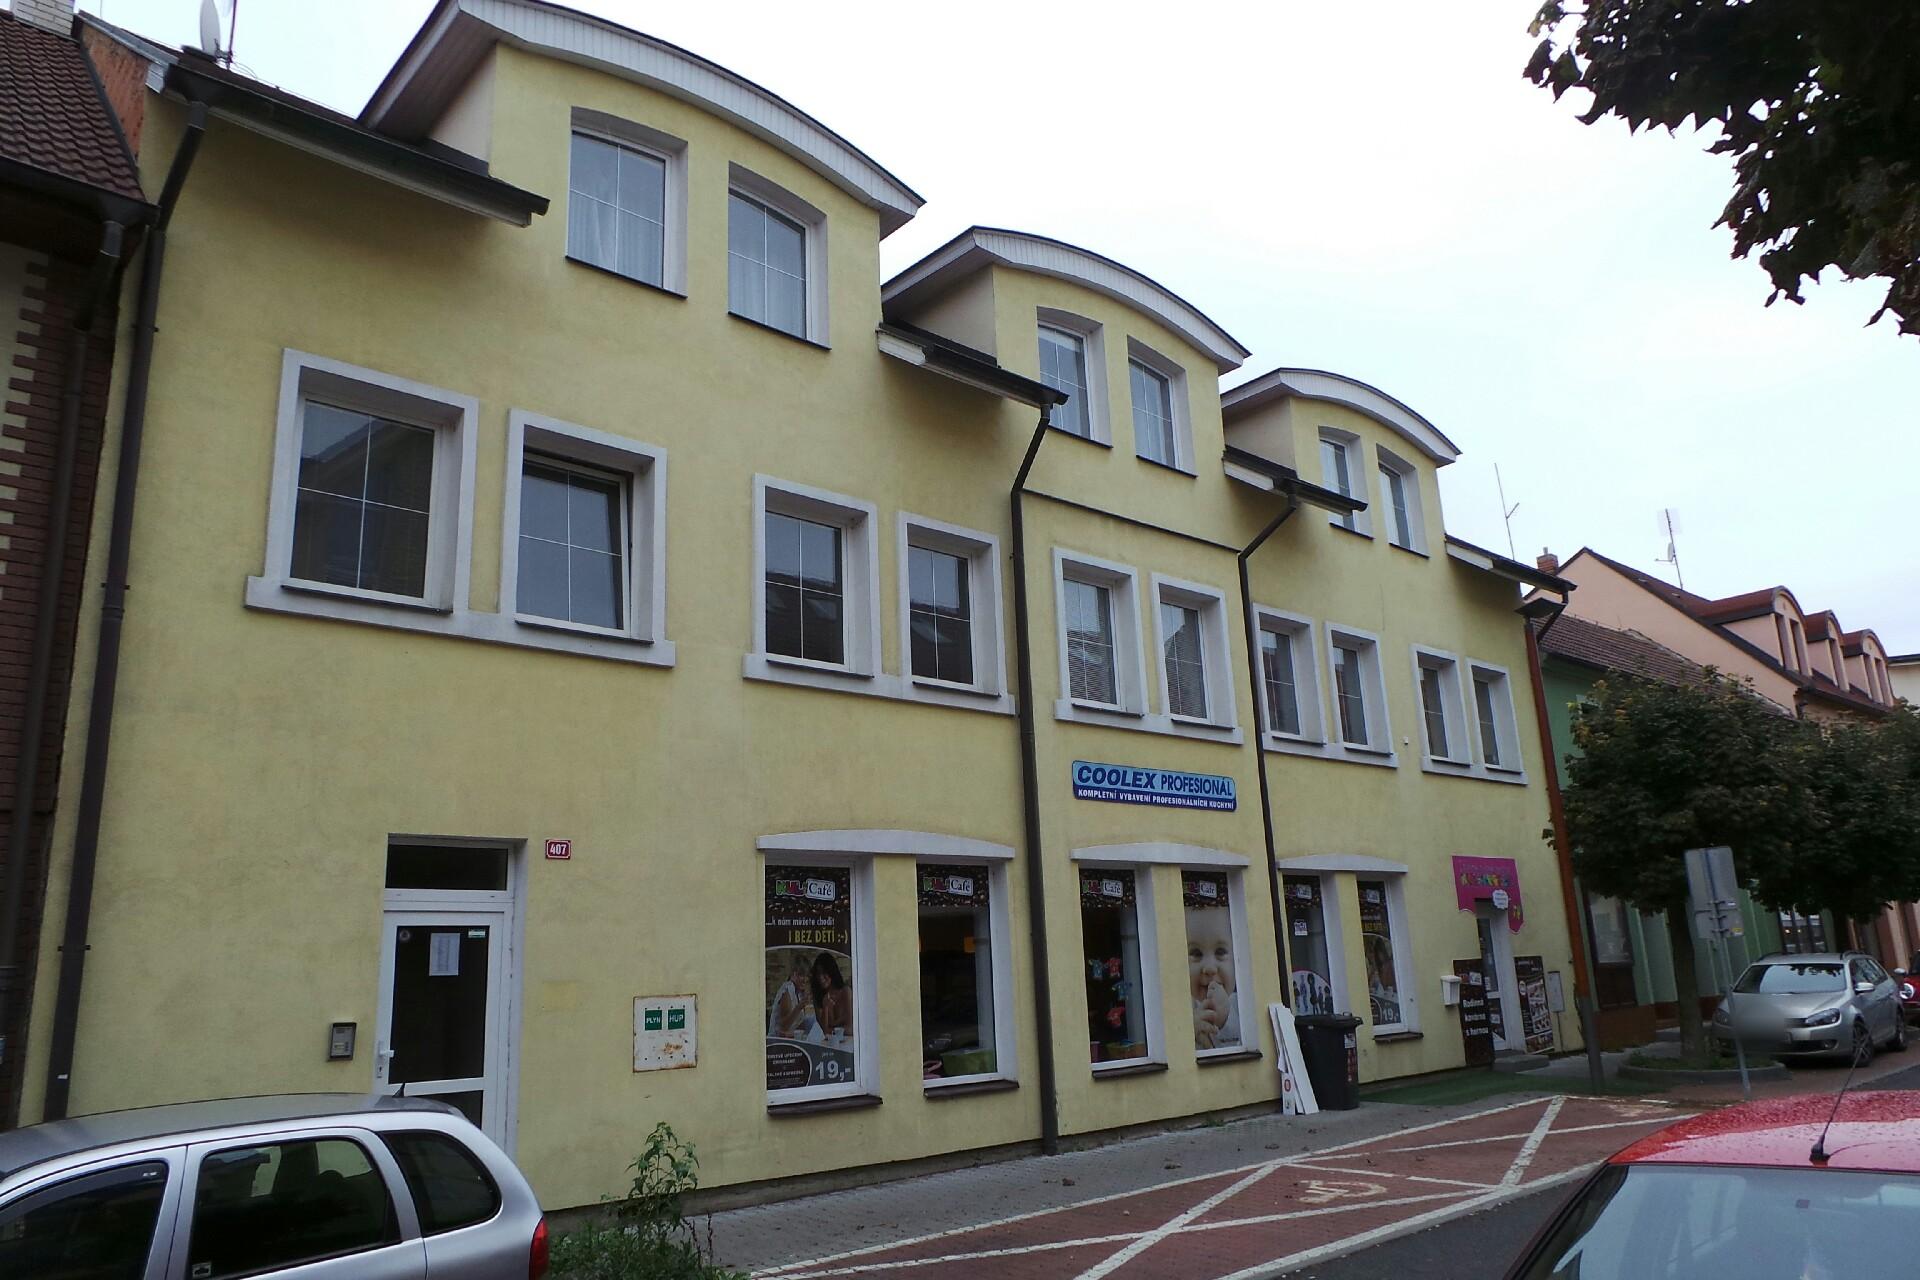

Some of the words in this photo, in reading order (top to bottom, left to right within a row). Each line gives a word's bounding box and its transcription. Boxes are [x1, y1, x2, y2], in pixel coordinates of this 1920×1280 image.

[1077, 765, 1157, 789] COOLEX
[1161, 774, 1233, 796] PROFESIONÁL
[1078, 788, 1117, 800] KOMPLETNÍ
[1119, 793, 1151, 803] VYBAVENÍ
[550, 843, 567, 855] 407
[808, 882, 832, 896] Café
[795, 930, 812, 943] BEZ
[815, 926, 835, 943] DĚTÍ
[646, 1016, 661, 1024] PLYN
[669, 1014, 684, 1023] HUP
[815, 1060, 851, 1082] 19,-
